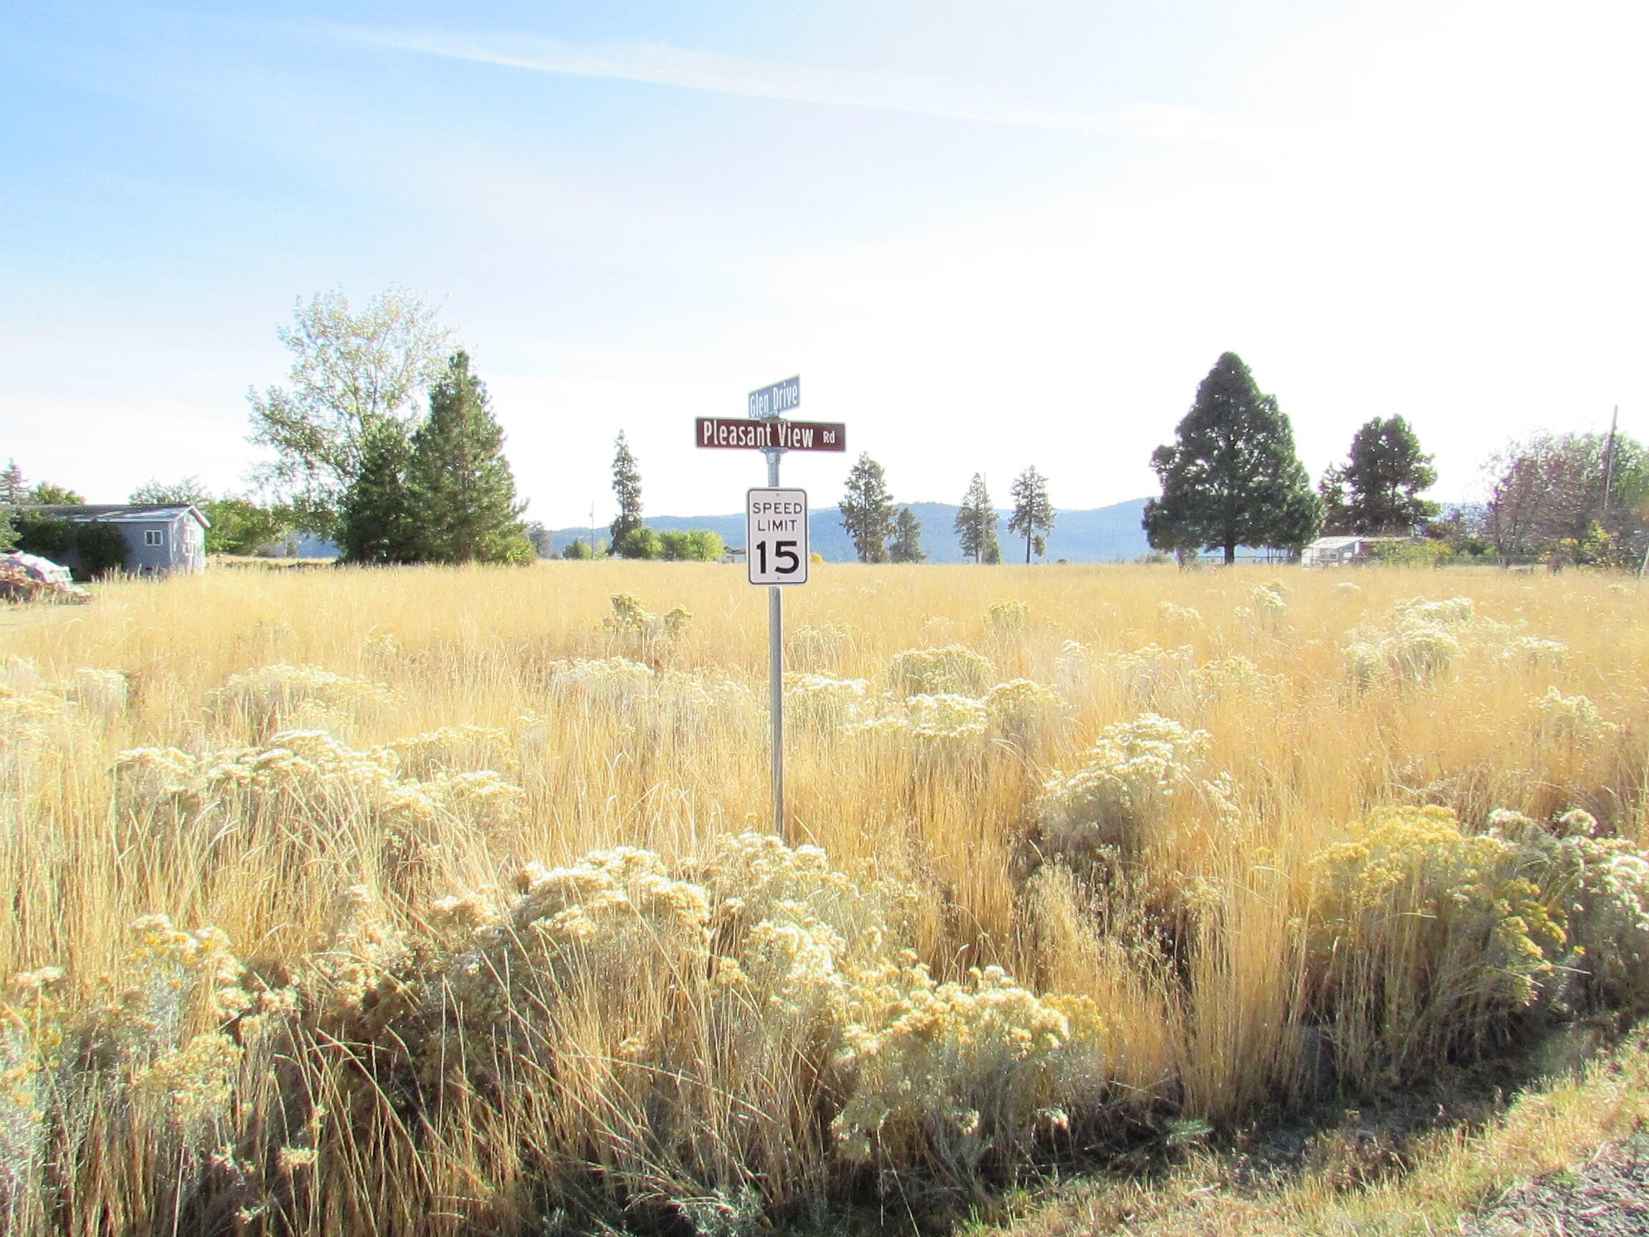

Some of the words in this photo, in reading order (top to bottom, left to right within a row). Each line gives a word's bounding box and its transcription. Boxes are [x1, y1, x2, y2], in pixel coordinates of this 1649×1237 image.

[750, 391, 769, 417] Glen
[773, 382, 798, 410] Drive
[703, 420, 772, 446] Pleasant
[778, 421, 814, 448] View
[823, 431, 836, 444] Rd
[752, 502, 802, 514] SPEED
[758, 520, 797, 531] LIMIT
[756, 540, 800, 574] 15
